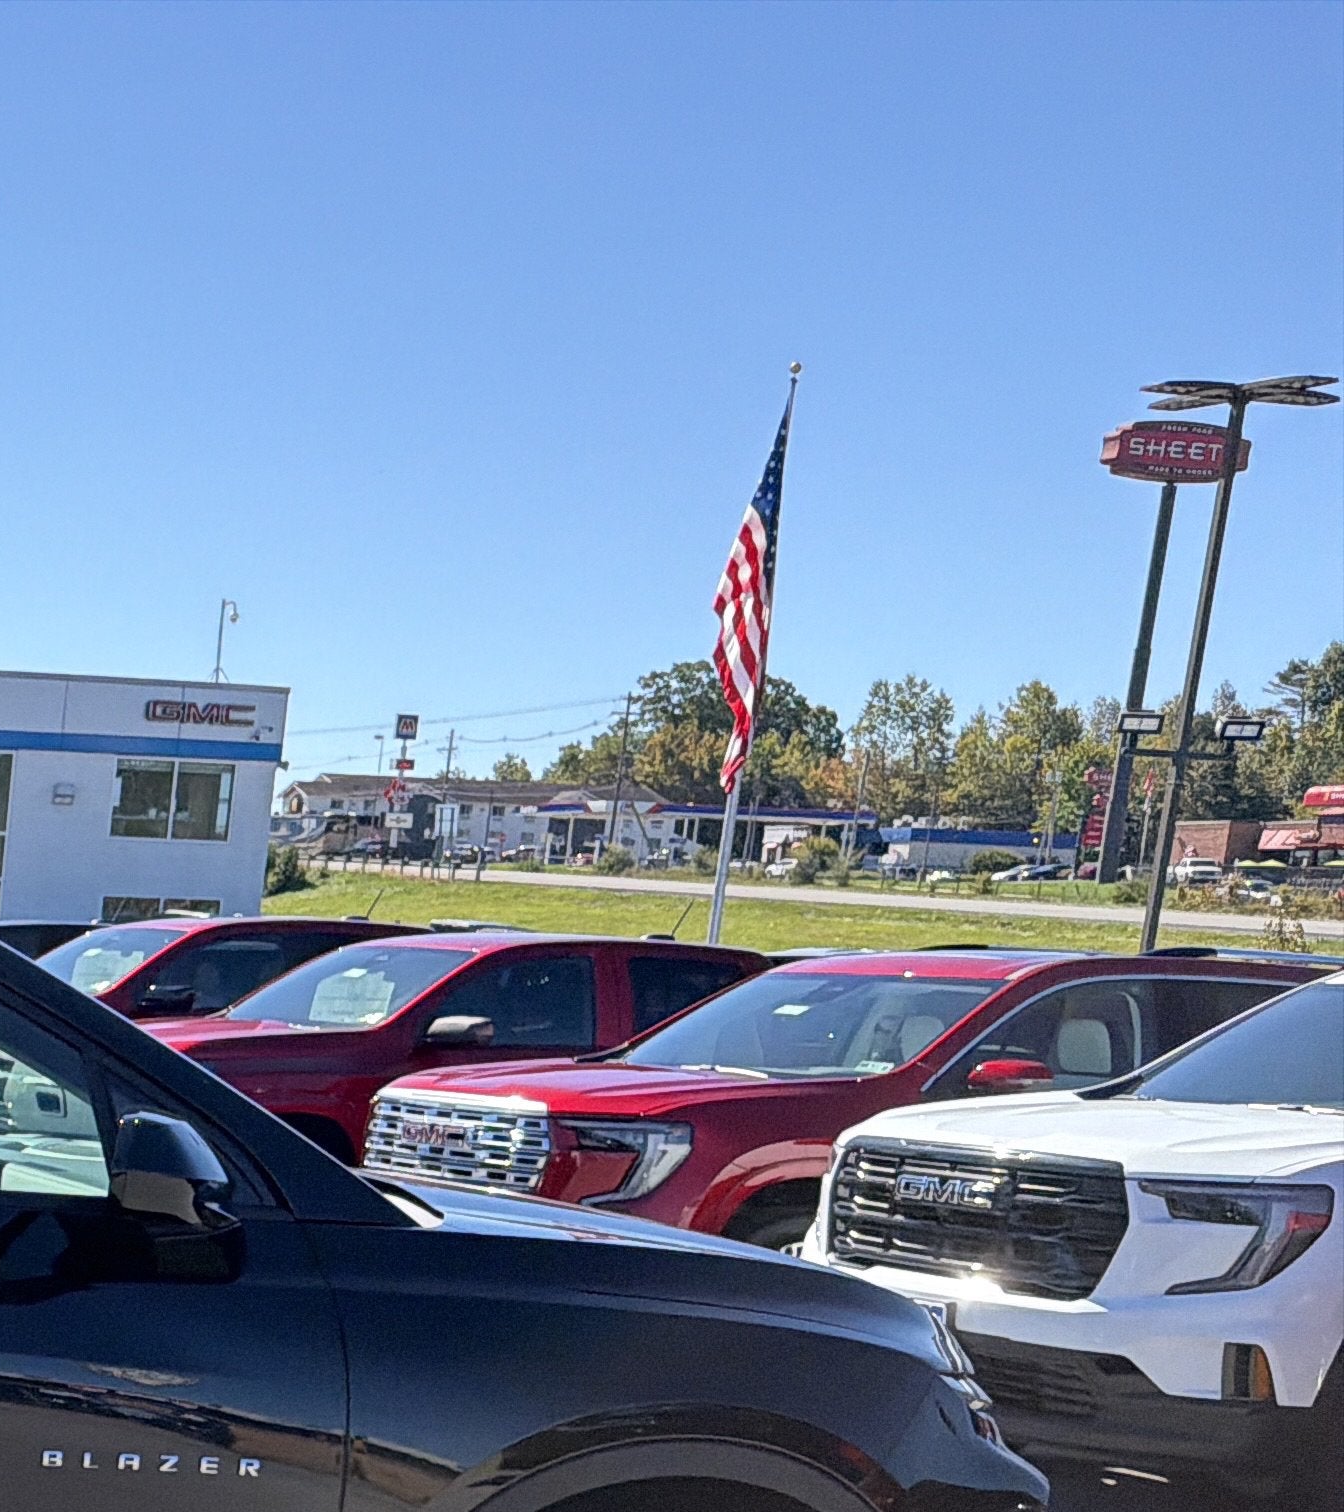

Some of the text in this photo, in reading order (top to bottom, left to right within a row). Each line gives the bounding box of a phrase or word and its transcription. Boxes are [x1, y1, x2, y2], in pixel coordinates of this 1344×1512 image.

[1129, 437, 1225, 462] SHEET
[145, 699, 257, 728] GMC
[402, 1120, 466, 1148] GMC
[895, 1173, 996, 1209] GMC
[41, 1449, 262, 1477] BLAZER
